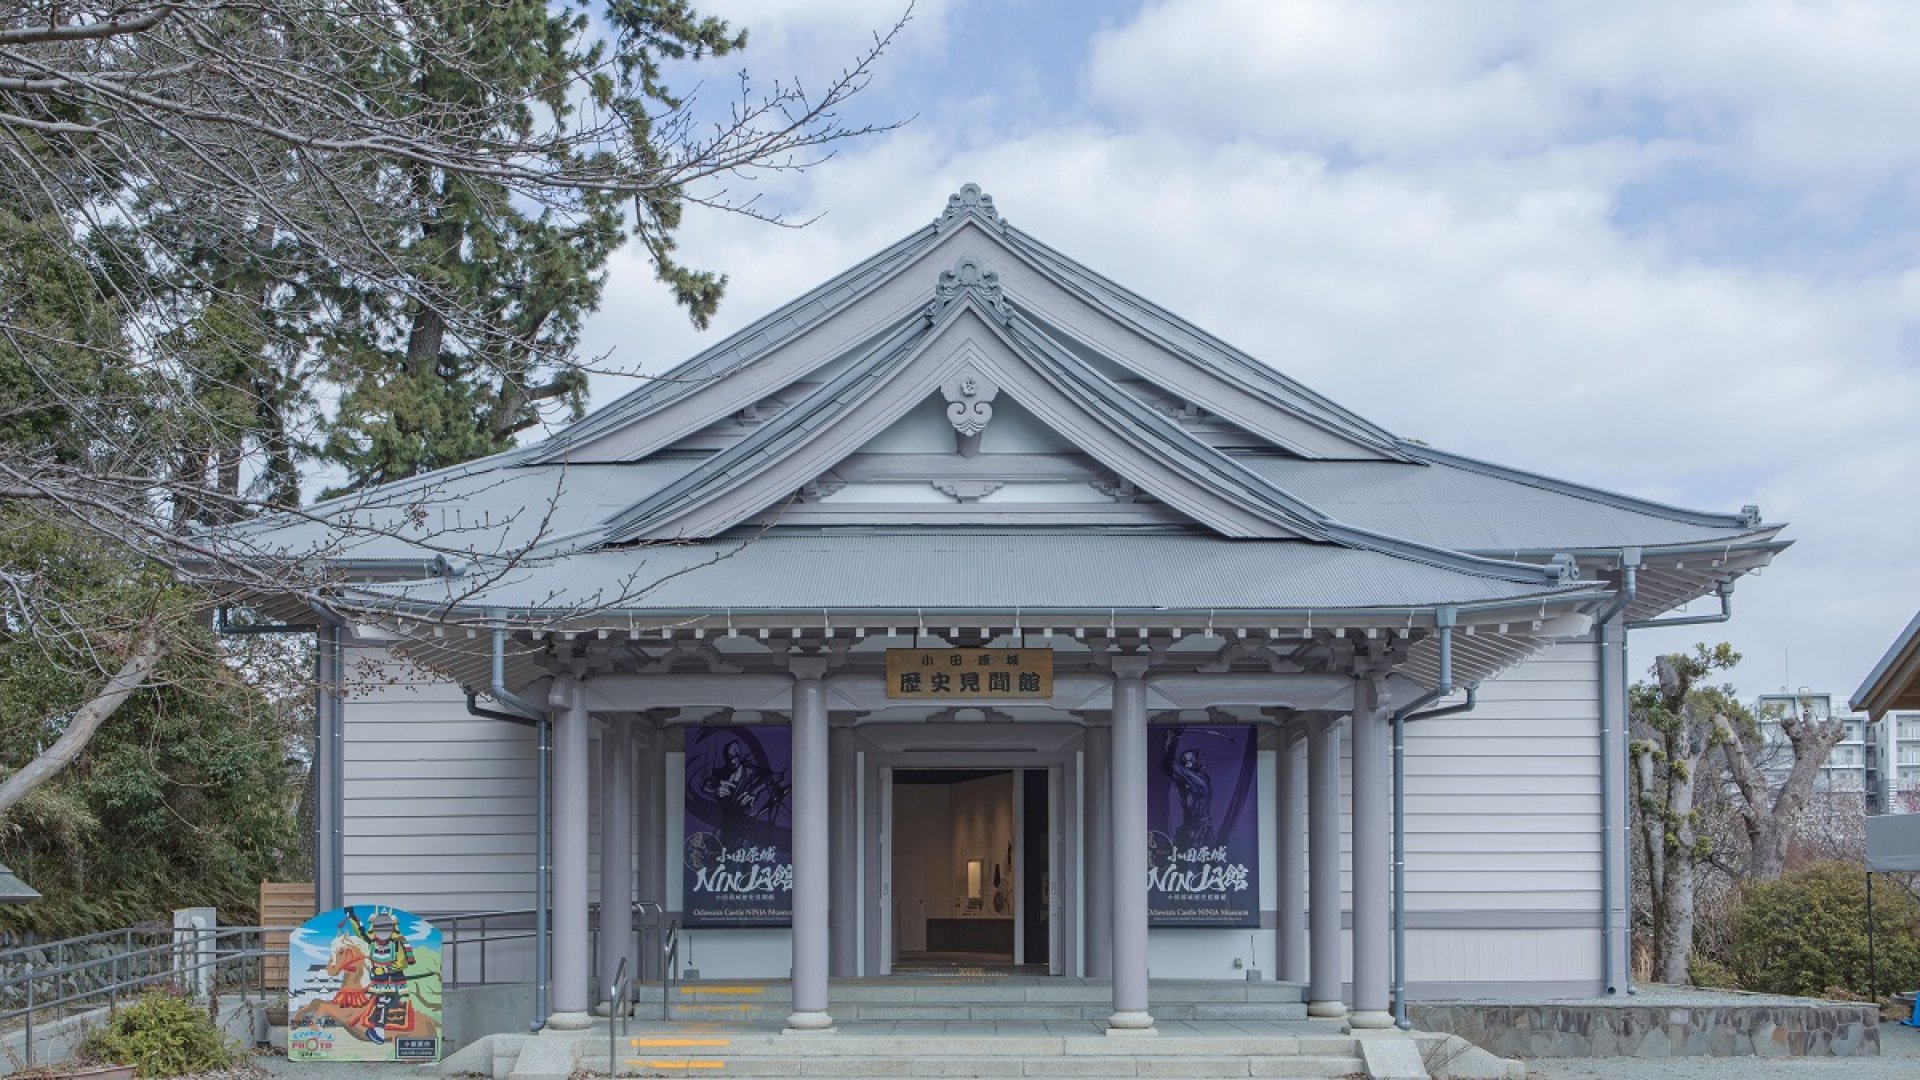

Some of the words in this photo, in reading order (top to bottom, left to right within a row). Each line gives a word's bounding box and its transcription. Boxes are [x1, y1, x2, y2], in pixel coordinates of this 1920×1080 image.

[921, 654, 1018, 666] 小田原城
[900, 671, 1040, 692] 歴史見聞館
[716, 846, 776, 862] 小田原城
[1168, 846, 1227, 862] 小田原城
[1147, 864, 1248, 892] NINJA館
